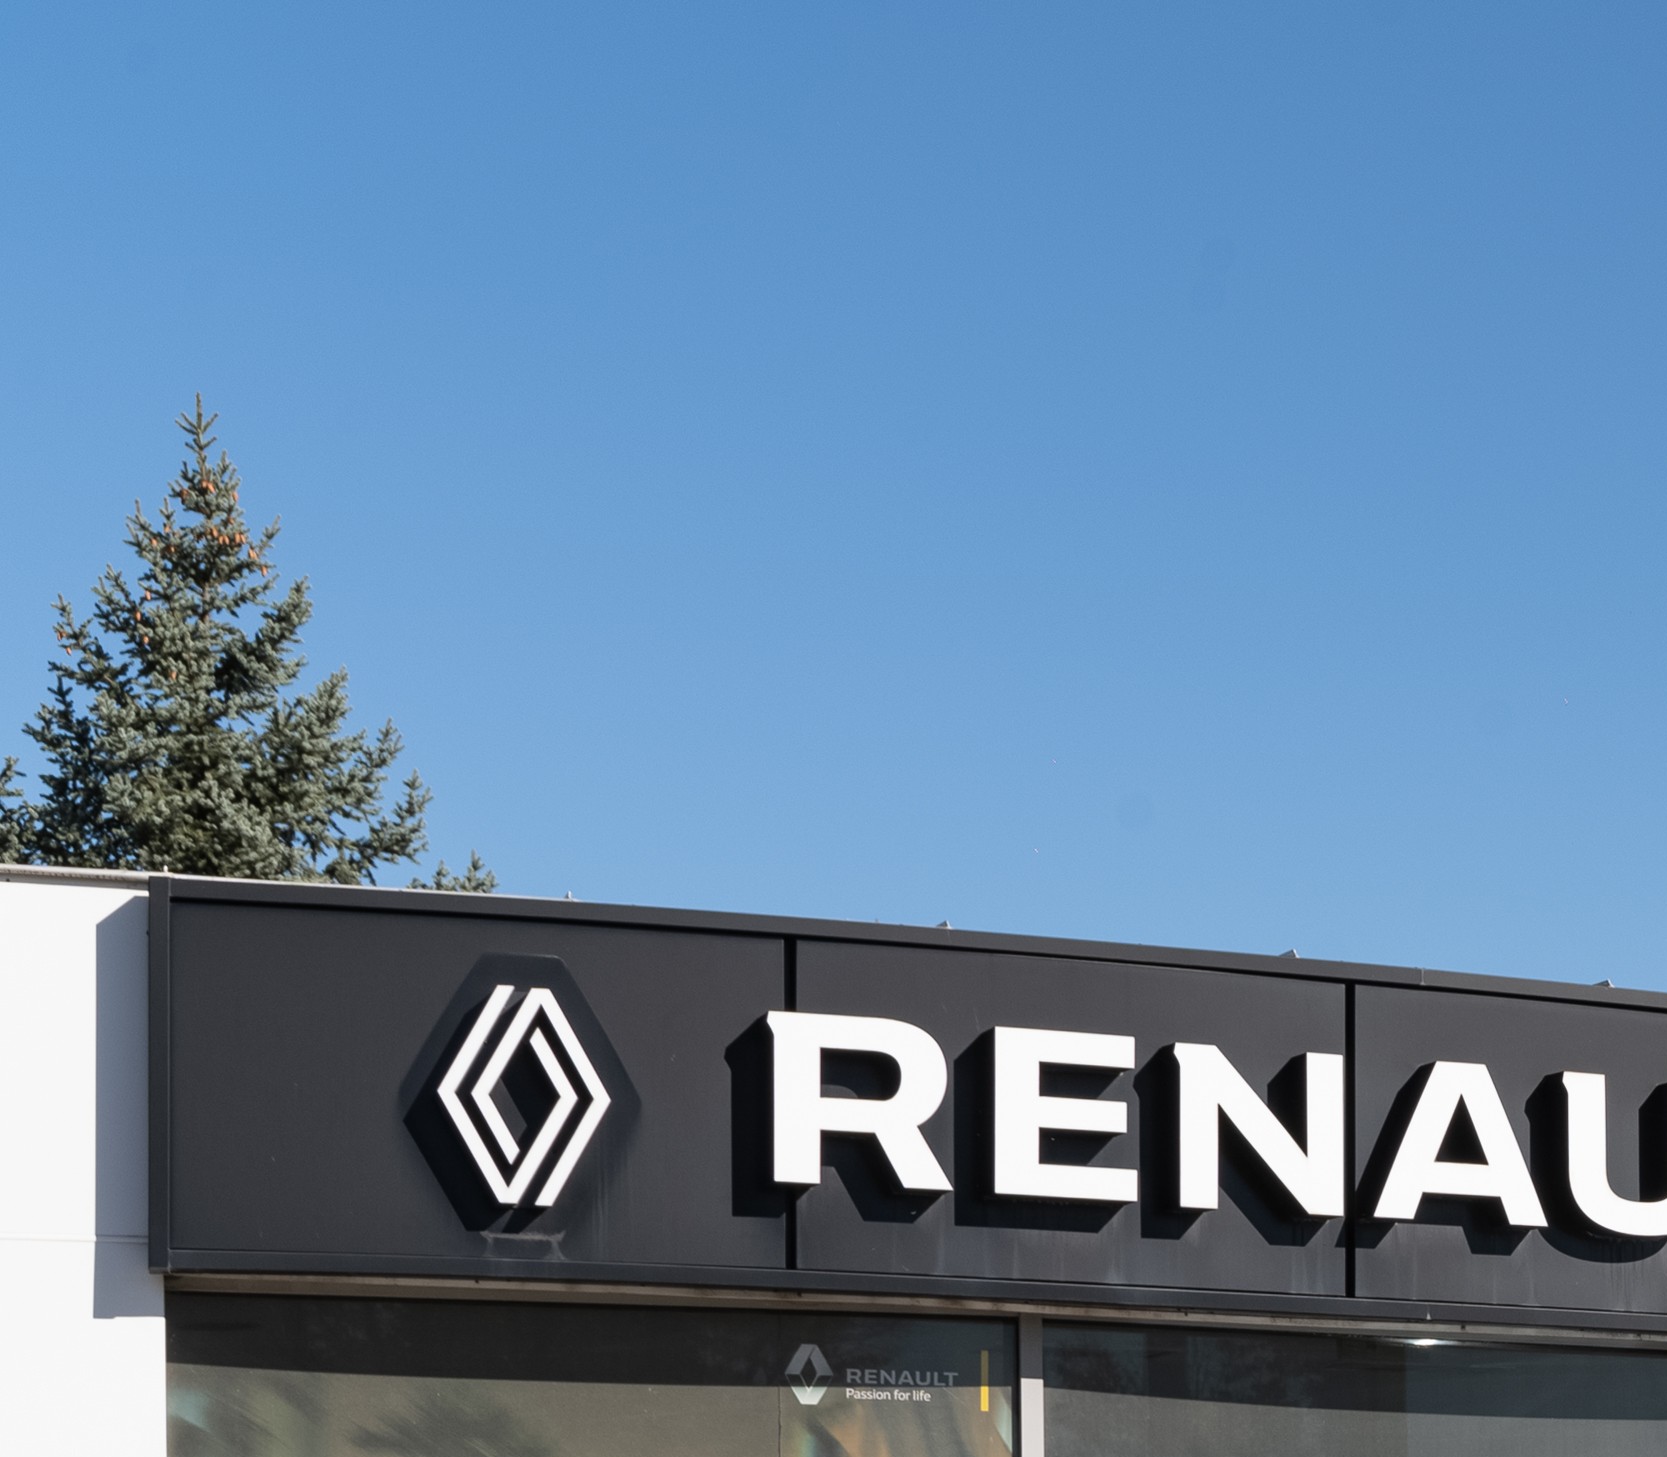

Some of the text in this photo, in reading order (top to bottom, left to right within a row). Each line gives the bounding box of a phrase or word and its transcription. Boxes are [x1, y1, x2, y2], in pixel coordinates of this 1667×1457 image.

[846, 1368, 958, 1386] RENAULT
[846, 1388, 931, 1401] Passion for life
